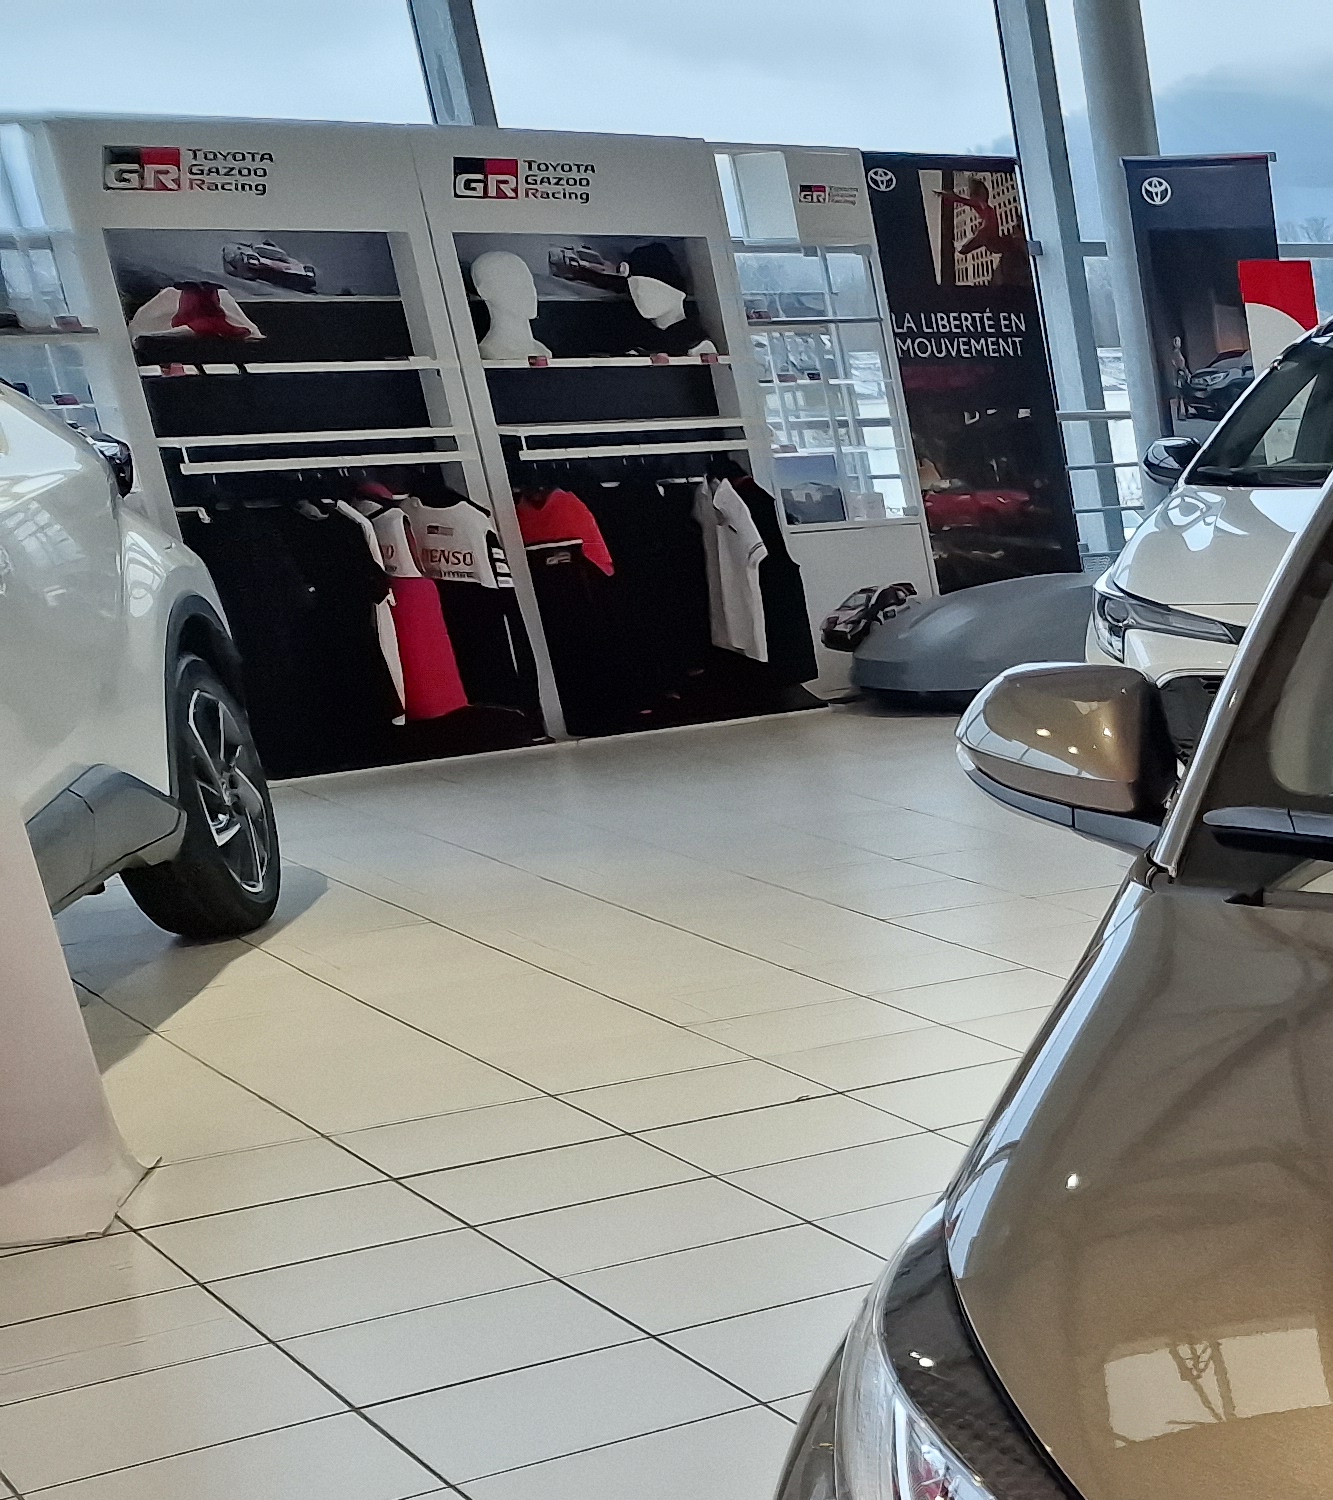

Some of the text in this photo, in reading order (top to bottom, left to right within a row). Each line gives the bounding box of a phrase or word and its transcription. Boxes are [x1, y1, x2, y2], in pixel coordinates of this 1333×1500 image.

[186, 148, 274, 163] TOYOTA
[188, 163, 268, 178] GAZOO
[523, 159, 596, 174] TOYOTA
[104, 163, 179, 191] GR
[455, 173, 518, 198] GR
[524, 174, 591, 187] GAZOO
[188, 178, 267, 196] Racing
[524, 187, 590, 204] Racing
[891, 307, 1026, 333] LA LIBERTÉ EN
[895, 336, 1024, 358] MOUVEMENT
